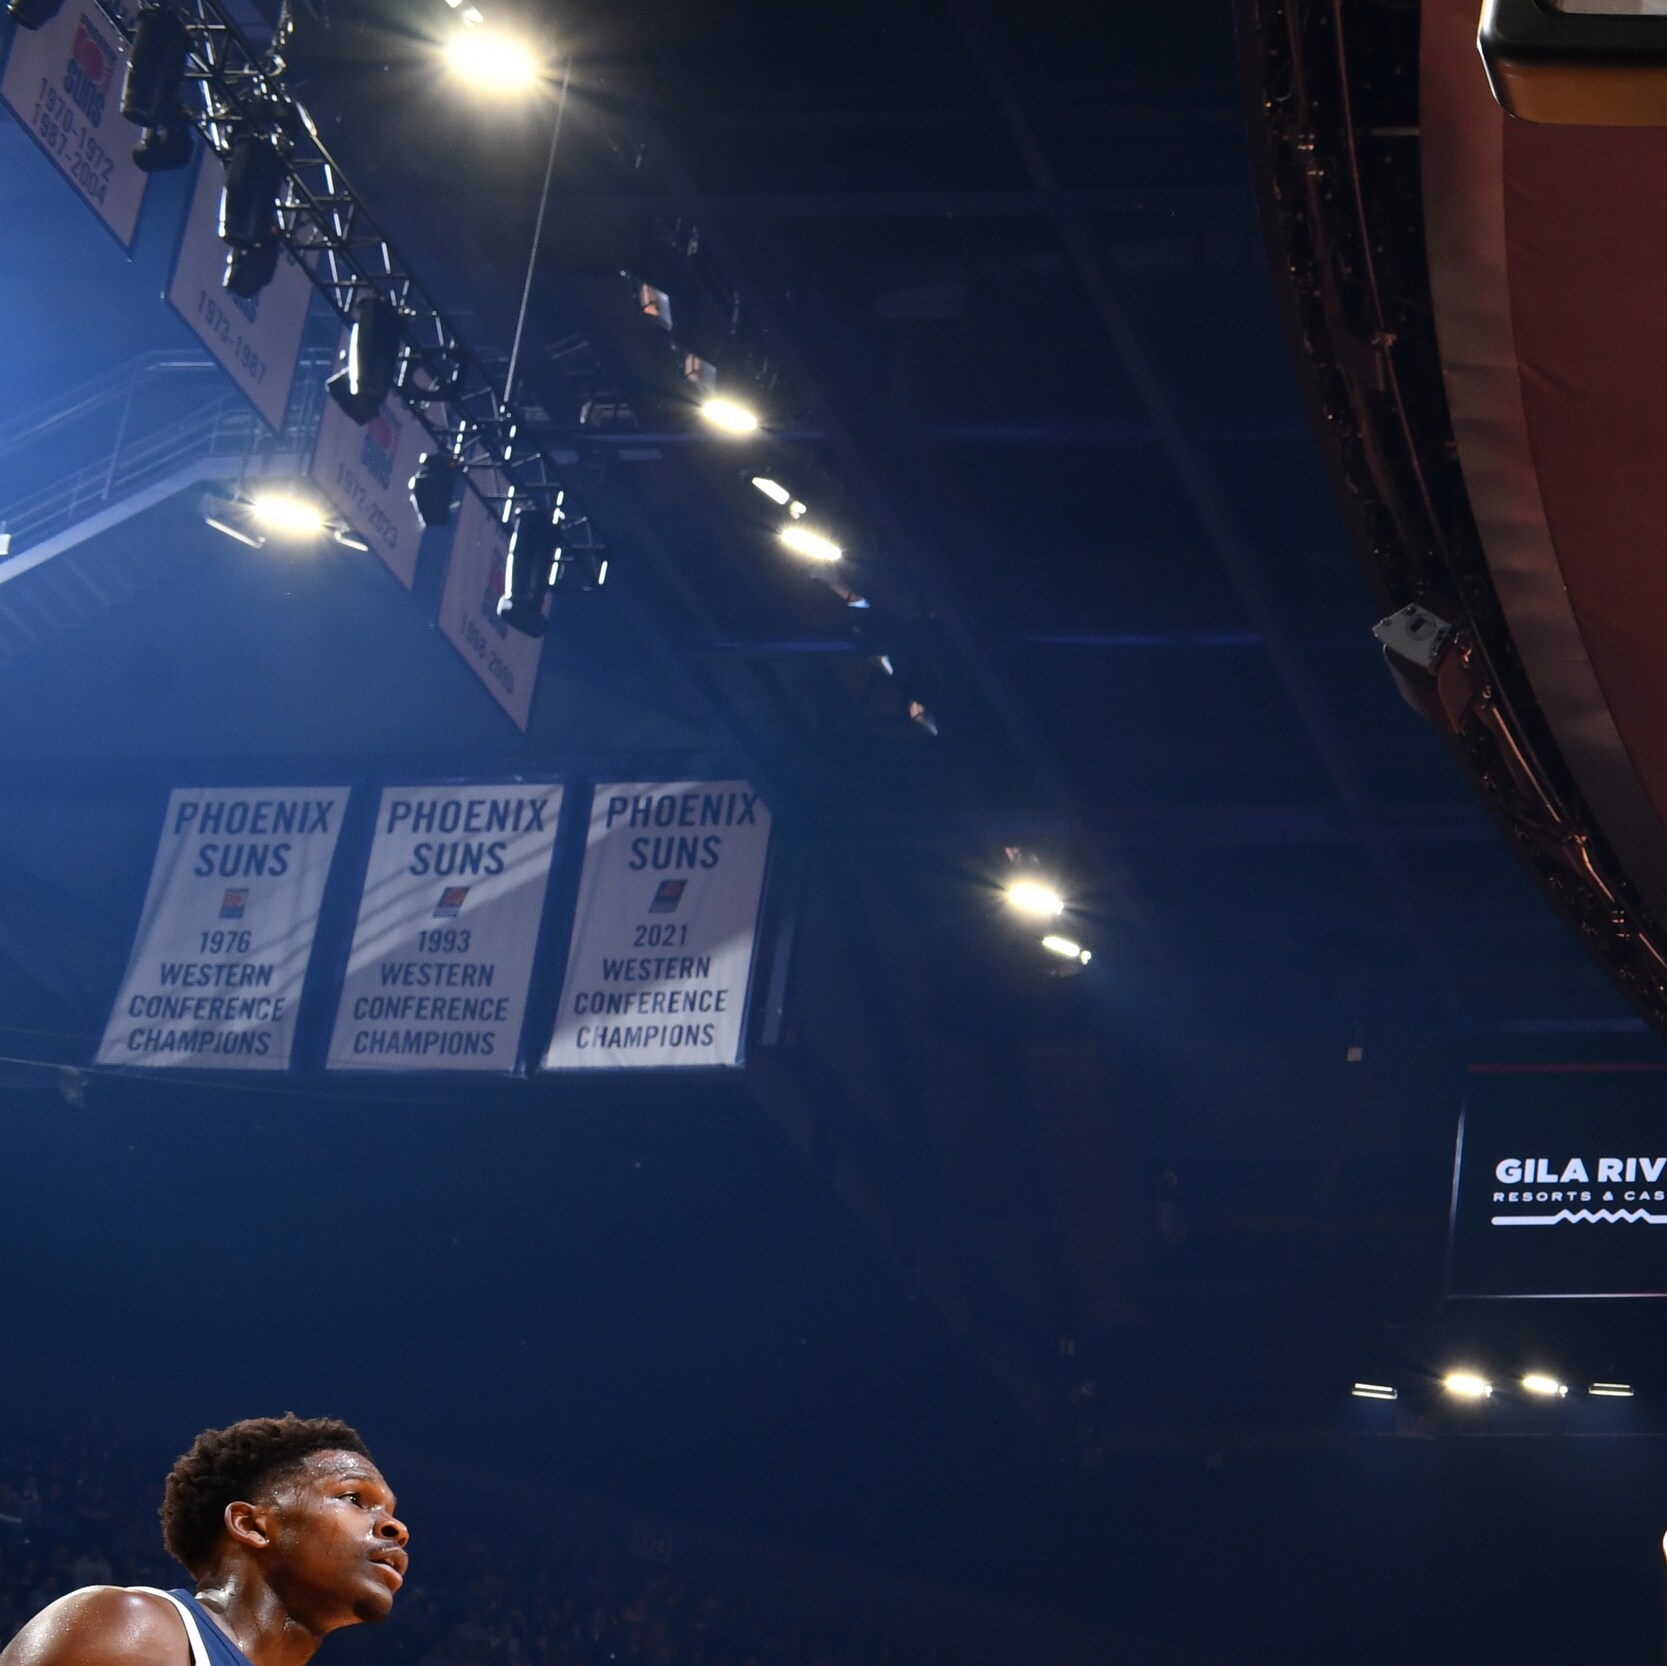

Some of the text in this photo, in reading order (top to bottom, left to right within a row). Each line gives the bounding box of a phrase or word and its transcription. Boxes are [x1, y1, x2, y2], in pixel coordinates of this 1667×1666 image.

[174, 800, 333, 835] PHOENIX
[387, 799, 547, 834] PHOENIX
[606, 793, 759, 829] PHOENIX
[195, 843, 291, 876] SUNS
[409, 842, 507, 876] SUNS
[628, 836, 721, 870] SUNS
[200, 931, 251, 953] 1976
[417, 930, 471, 952] 1993
[633, 924, 688, 947] 2021
[160, 963, 274, 987] WESTERN
[381, 963, 494, 987] WESTERN
[602, 956, 711, 981] WESTERN
[128, 996, 286, 1021] CONFERENCE
[353, 997, 509, 1021] CONFERENCE
[574, 989, 728, 1015] CONFERENCE
[127, 1029, 271, 1055] CHAMPIONS
[353, 1031, 495, 1055] CHAMPIONS
[576, 1024, 715, 1049] CHAMPIONS
[1495, 1157, 1590, 1184] GILA
[1493, 1191, 1591, 1202] RESORTS
[1602, 1191, 1613, 1202] &
